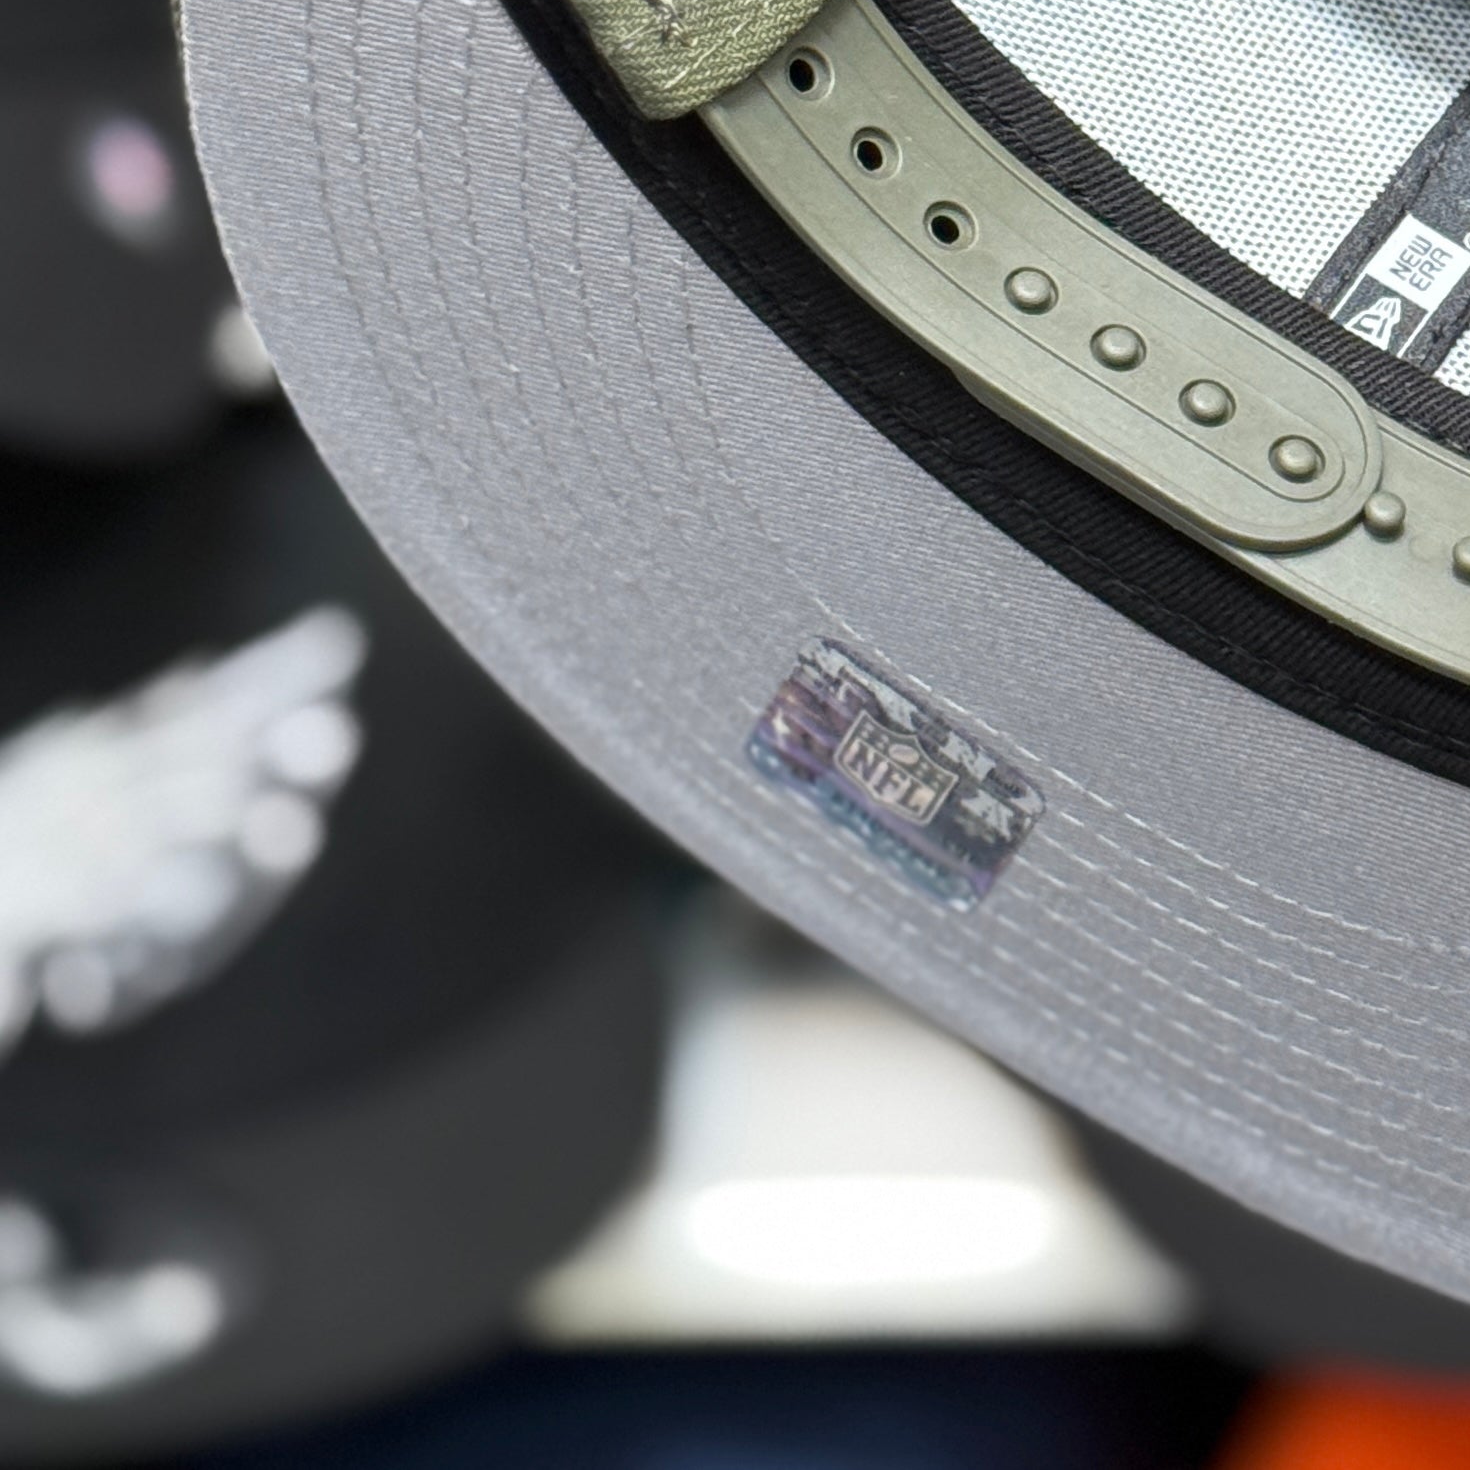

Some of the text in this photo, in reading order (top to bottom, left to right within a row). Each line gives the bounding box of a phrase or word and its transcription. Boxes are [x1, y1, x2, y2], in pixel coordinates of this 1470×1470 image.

[1389, 233, 1432, 281] NEW
[1409, 248, 1453, 293] ERA
[847, 742, 925, 813] NFL
